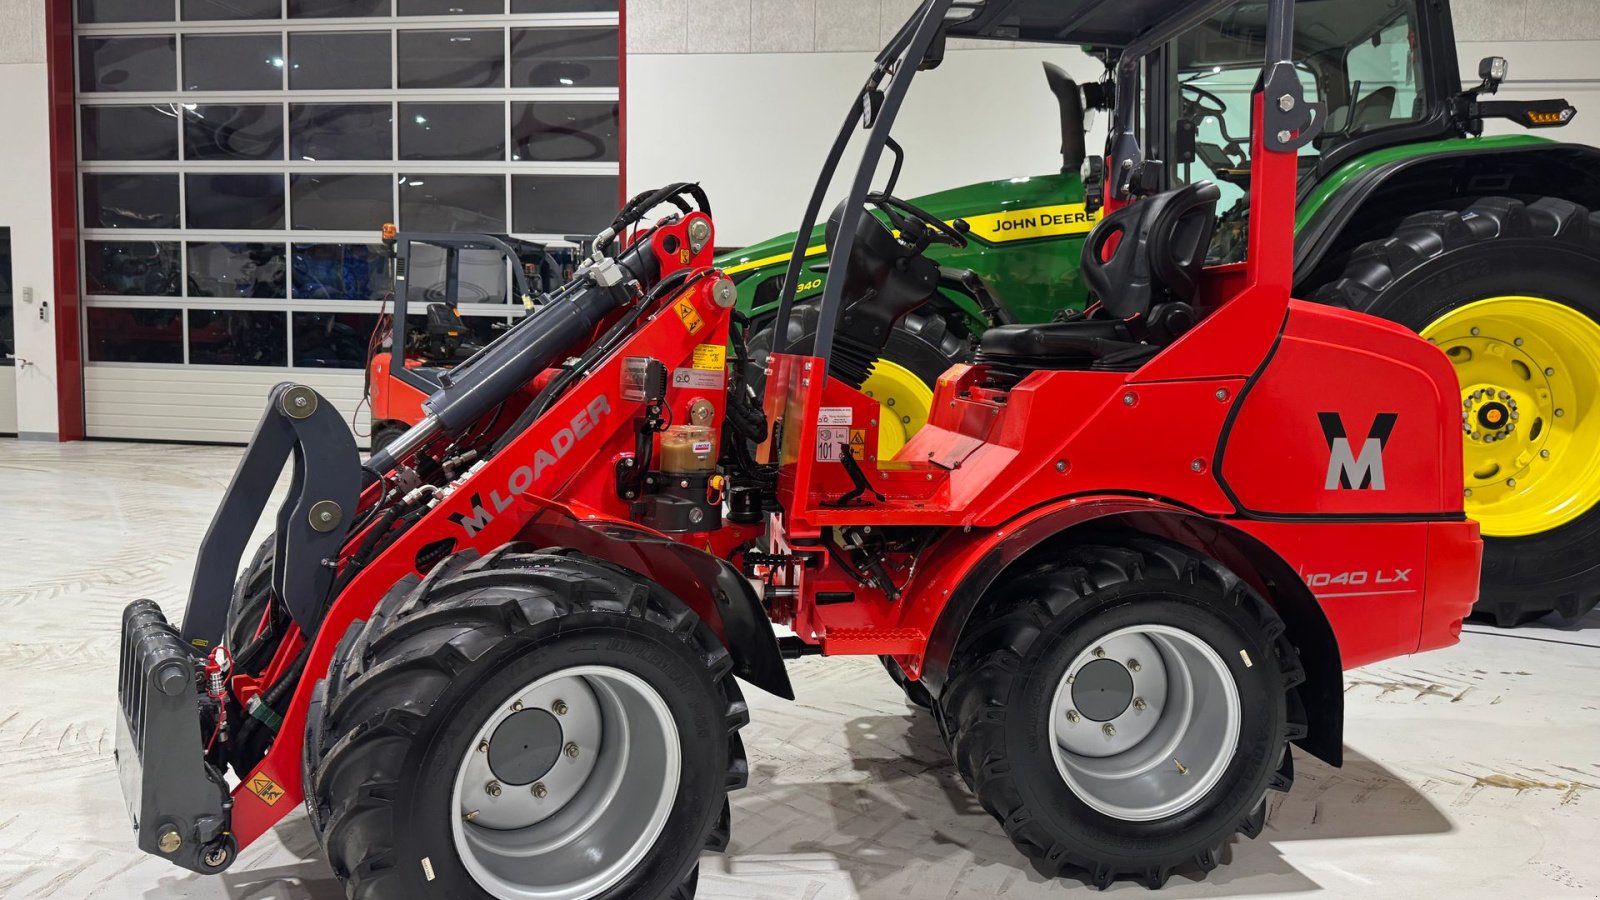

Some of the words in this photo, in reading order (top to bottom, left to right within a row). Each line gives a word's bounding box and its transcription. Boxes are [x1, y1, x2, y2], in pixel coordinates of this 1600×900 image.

[992, 217, 1036, 232] JOHN
[1040, 212, 1096, 226] DEERE
[796, 279, 822, 293] 340
[489, 394, 611, 514] LOADER
[818, 442, 832, 459] 101
[1306, 571, 1368, 587] 1040
[1375, 568, 1413, 583] LX
